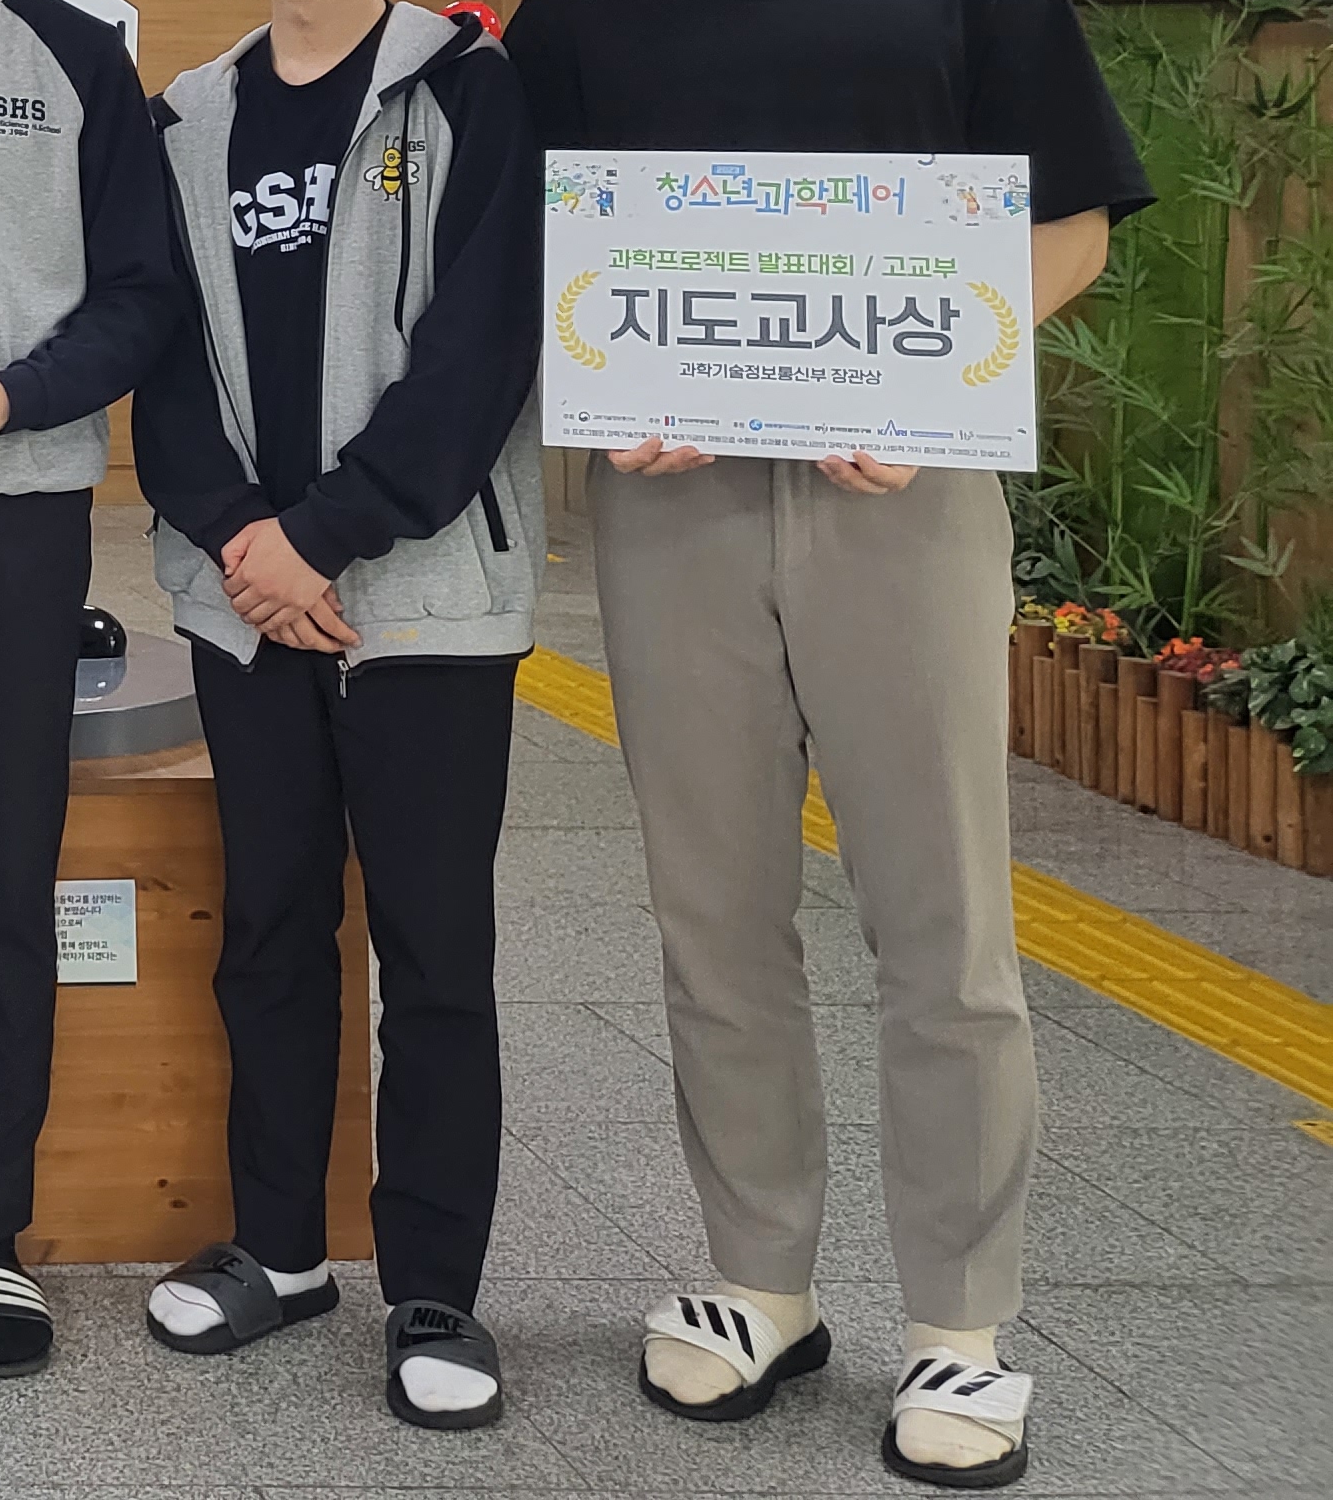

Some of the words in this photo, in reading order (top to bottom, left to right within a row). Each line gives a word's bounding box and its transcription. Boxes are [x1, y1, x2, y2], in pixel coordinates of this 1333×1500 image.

[656, 172, 905, 215] 청소년과학페어
[609, 249, 750, 273] 과학프로젝트
[758, 251, 854, 276] 발표대회
[882, 255, 958, 279] 고교부
[610, 287, 960, 357] 지도교사상
[680, 363, 827, 384] 과학기술정보통신부
[831, 366, 882, 386] 장관상
[56, 895, 89, 904] 등학교를
[57, 919, 82, 927] 으로써
[59, 952, 84, 961] 학자가
[410, 1307, 469, 1333] NIKE
